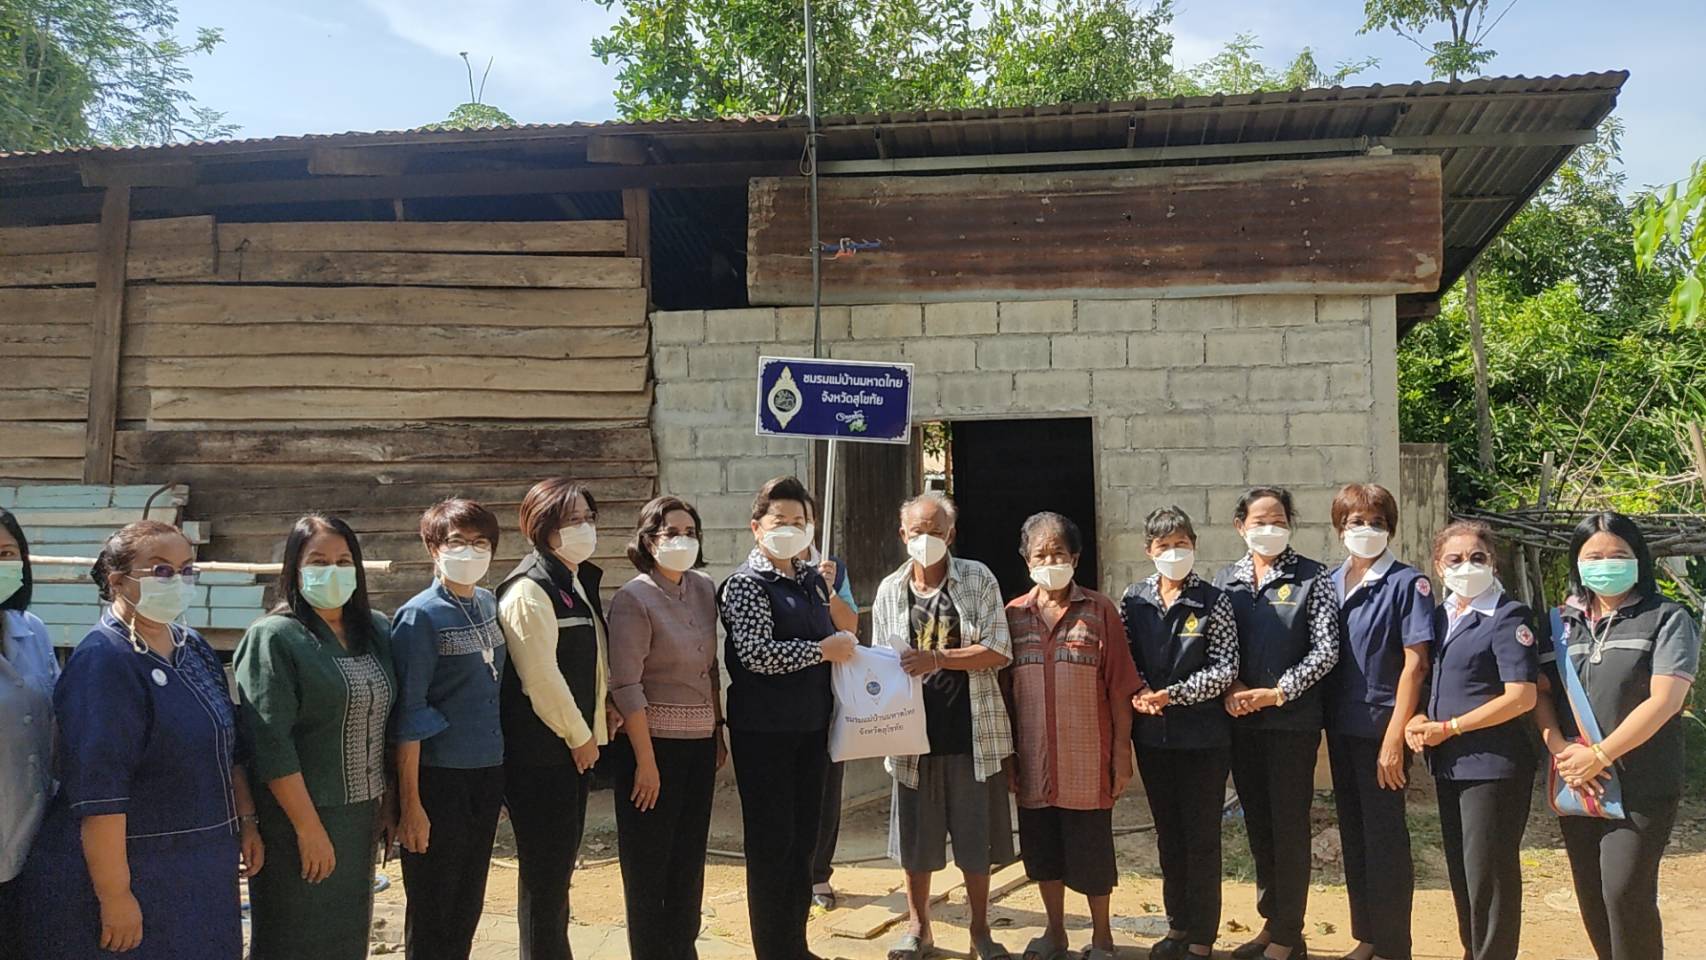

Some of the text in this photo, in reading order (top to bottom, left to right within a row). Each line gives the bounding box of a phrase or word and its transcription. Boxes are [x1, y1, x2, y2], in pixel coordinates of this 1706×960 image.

[803, 373, 904, 388] ชมรมแม่บ้านมหาดไทย
[821, 390, 884, 407] จังหวัดสุโขทัย
